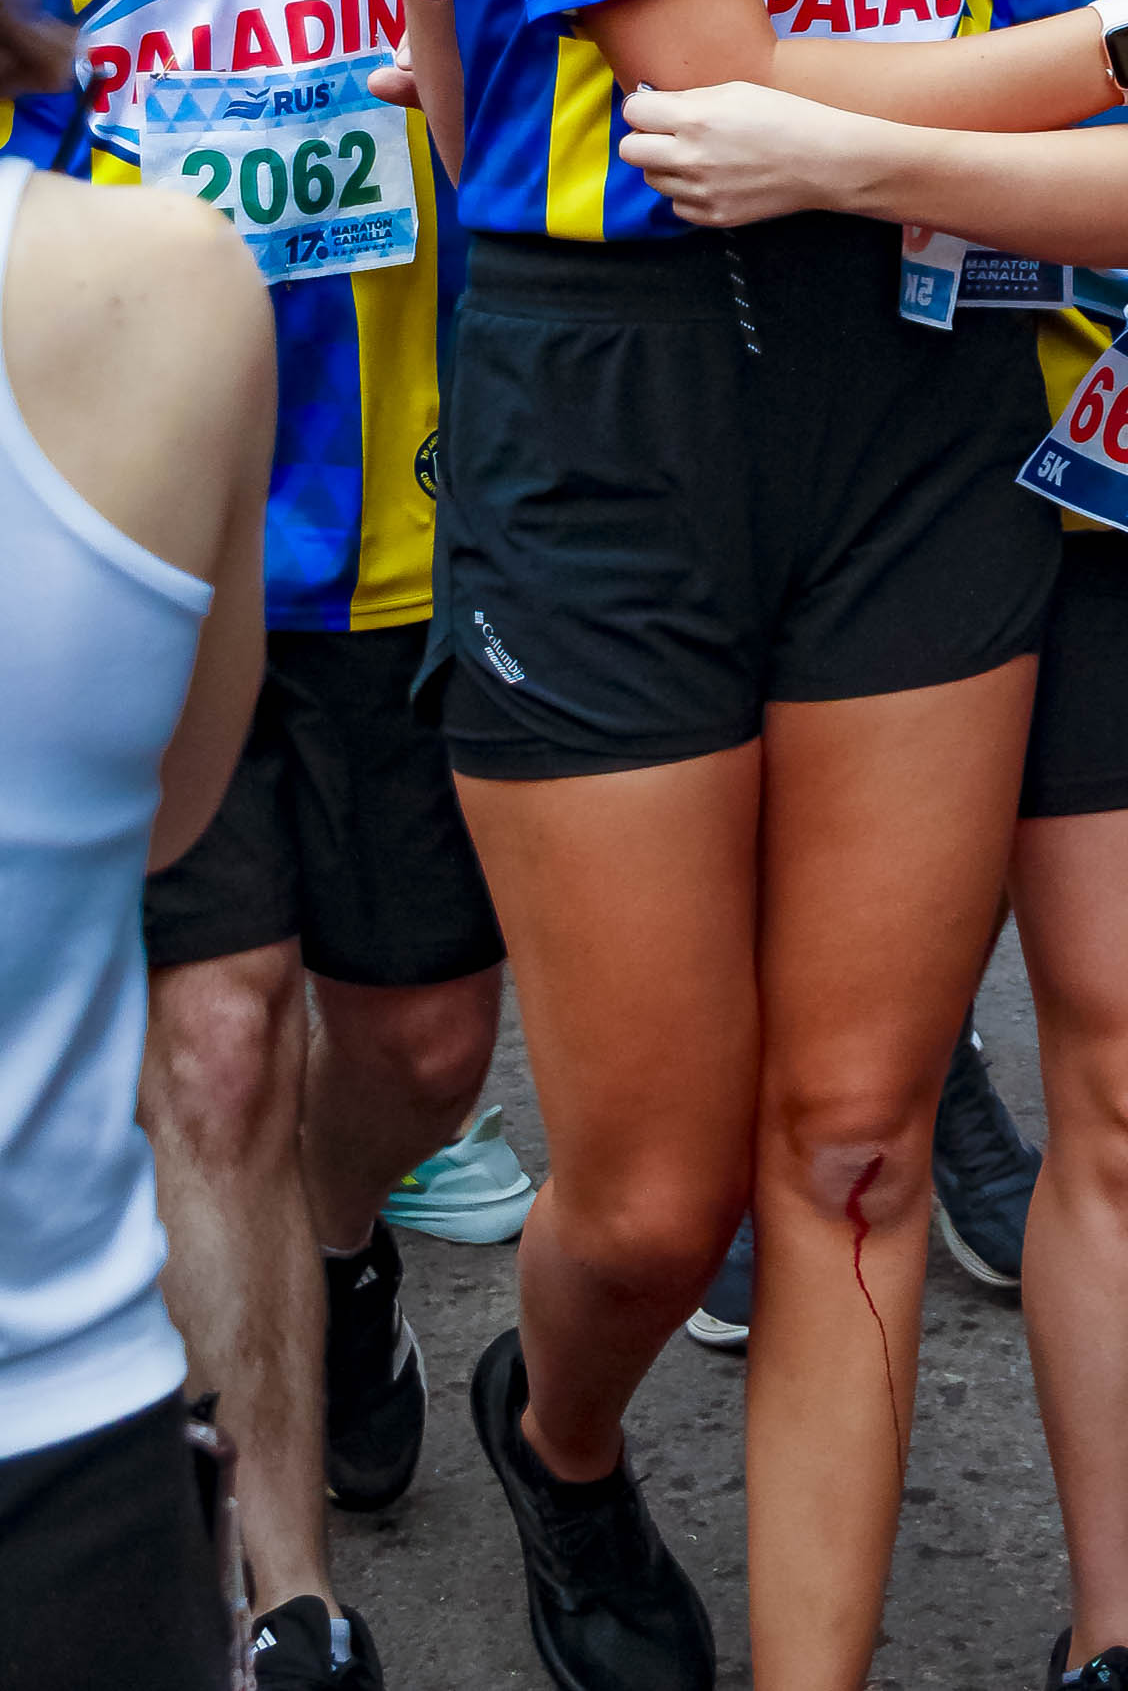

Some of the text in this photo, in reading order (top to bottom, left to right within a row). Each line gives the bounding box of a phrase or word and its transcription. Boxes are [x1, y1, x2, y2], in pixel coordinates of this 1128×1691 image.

[273, 83, 332, 116] RUS
[181, 130, 382, 225] 2062
[331, 217, 393, 236] MARATÓN
[333, 229, 393, 247] CANALLA
[966, 270, 1039, 281] CANALLA
[1037, 450, 1071, 487] 5K
[482, 623, 525, 681] Columbia
